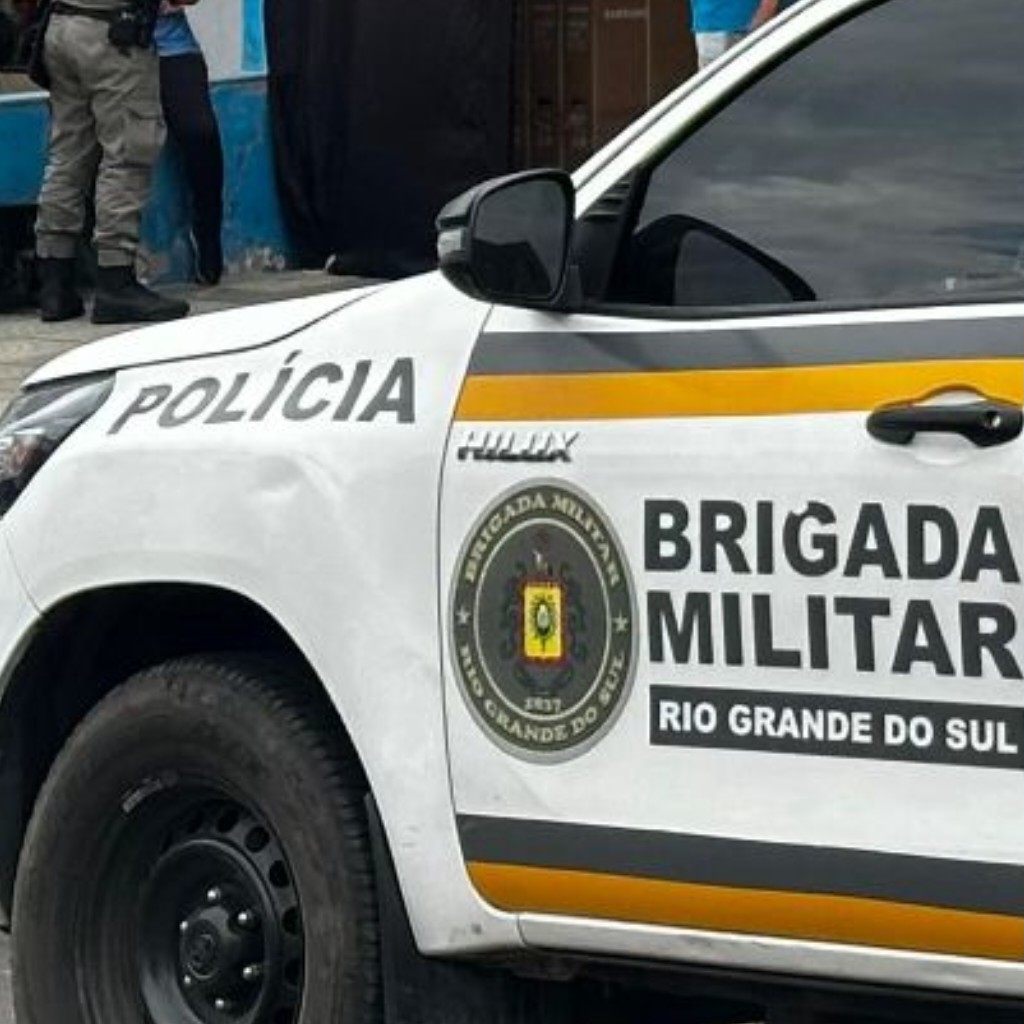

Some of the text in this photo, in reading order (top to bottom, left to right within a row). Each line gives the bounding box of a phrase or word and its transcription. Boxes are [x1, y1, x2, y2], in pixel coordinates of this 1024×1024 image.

[107, 350, 417, 434] POLÍCIA
[458, 431, 580, 462] HILUX
[464, 492, 621, 586] BRIGADA MILITAR
[644, 498, 1021, 583] BRIGADA
[646, 590, 1024, 680] MILITAR
[459, 645, 626, 743] RIO GRANDE DO SUL
[658, 700, 1018, 754] RIO GRANDE DO SUL
